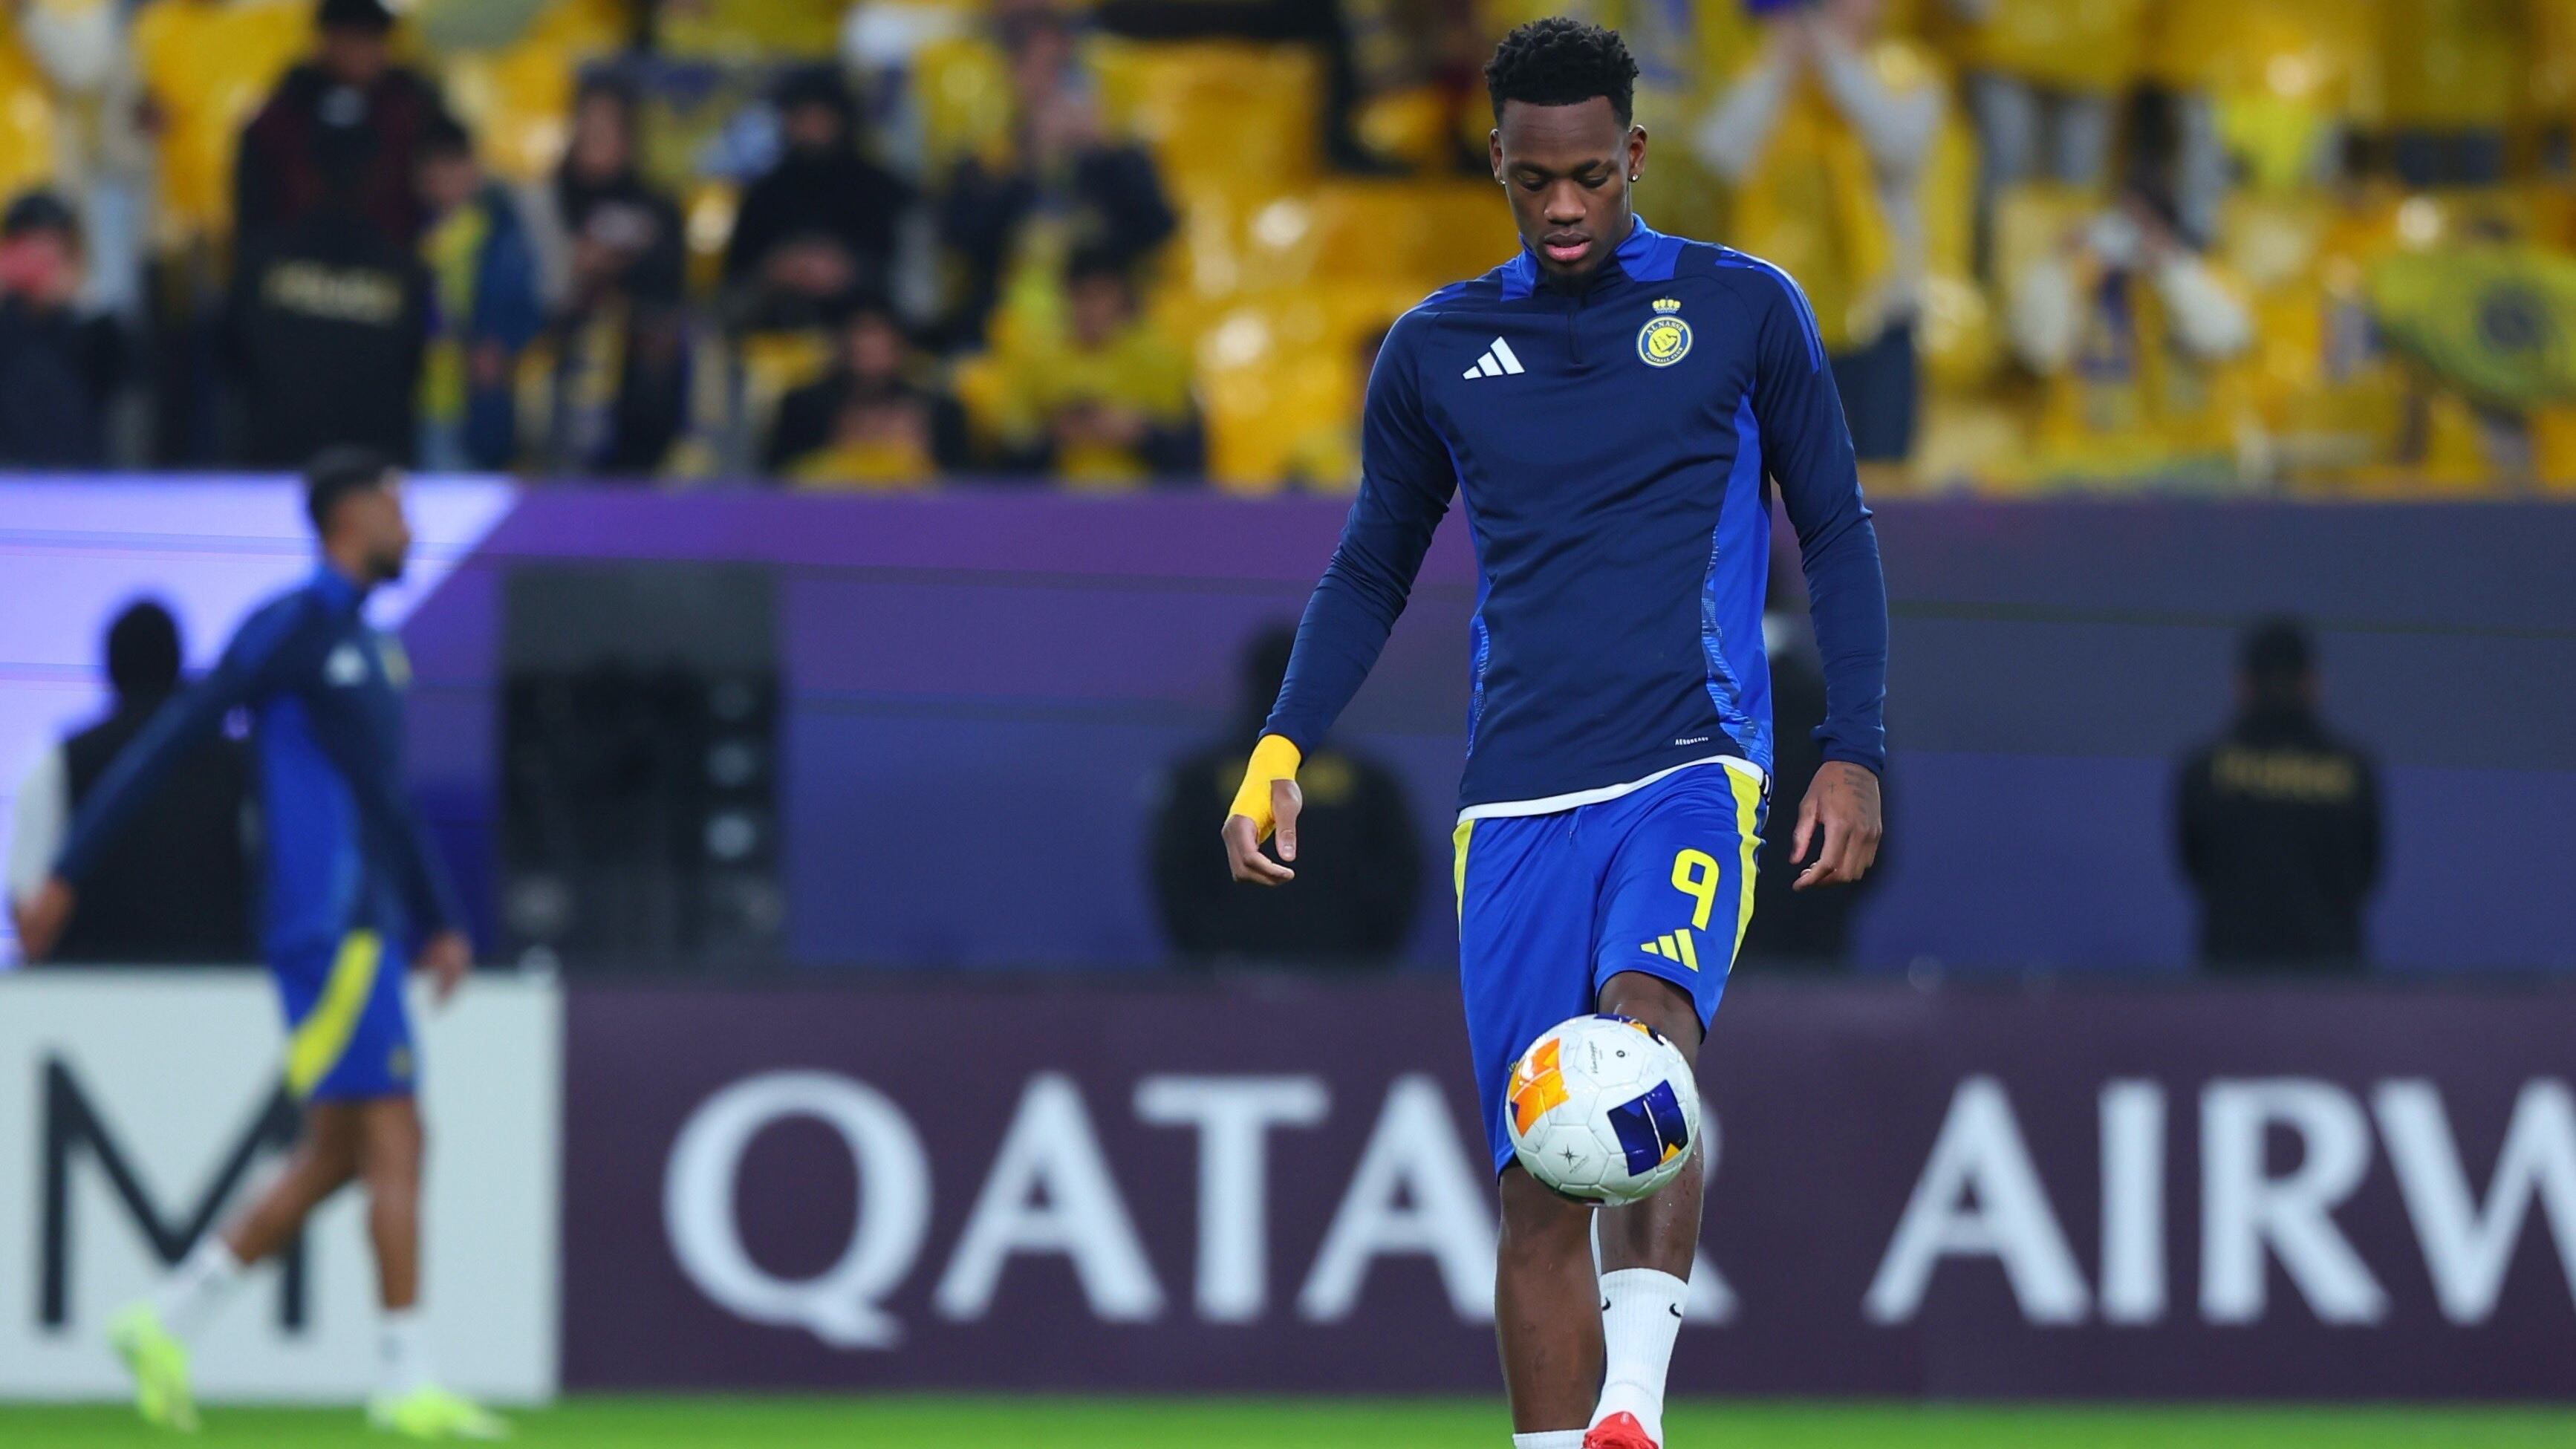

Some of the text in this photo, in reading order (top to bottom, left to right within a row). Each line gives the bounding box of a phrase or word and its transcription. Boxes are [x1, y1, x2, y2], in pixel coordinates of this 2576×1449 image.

[1671, 848, 1720, 932] 9
[663, 1069, 2576, 1347] QATA AIRW
